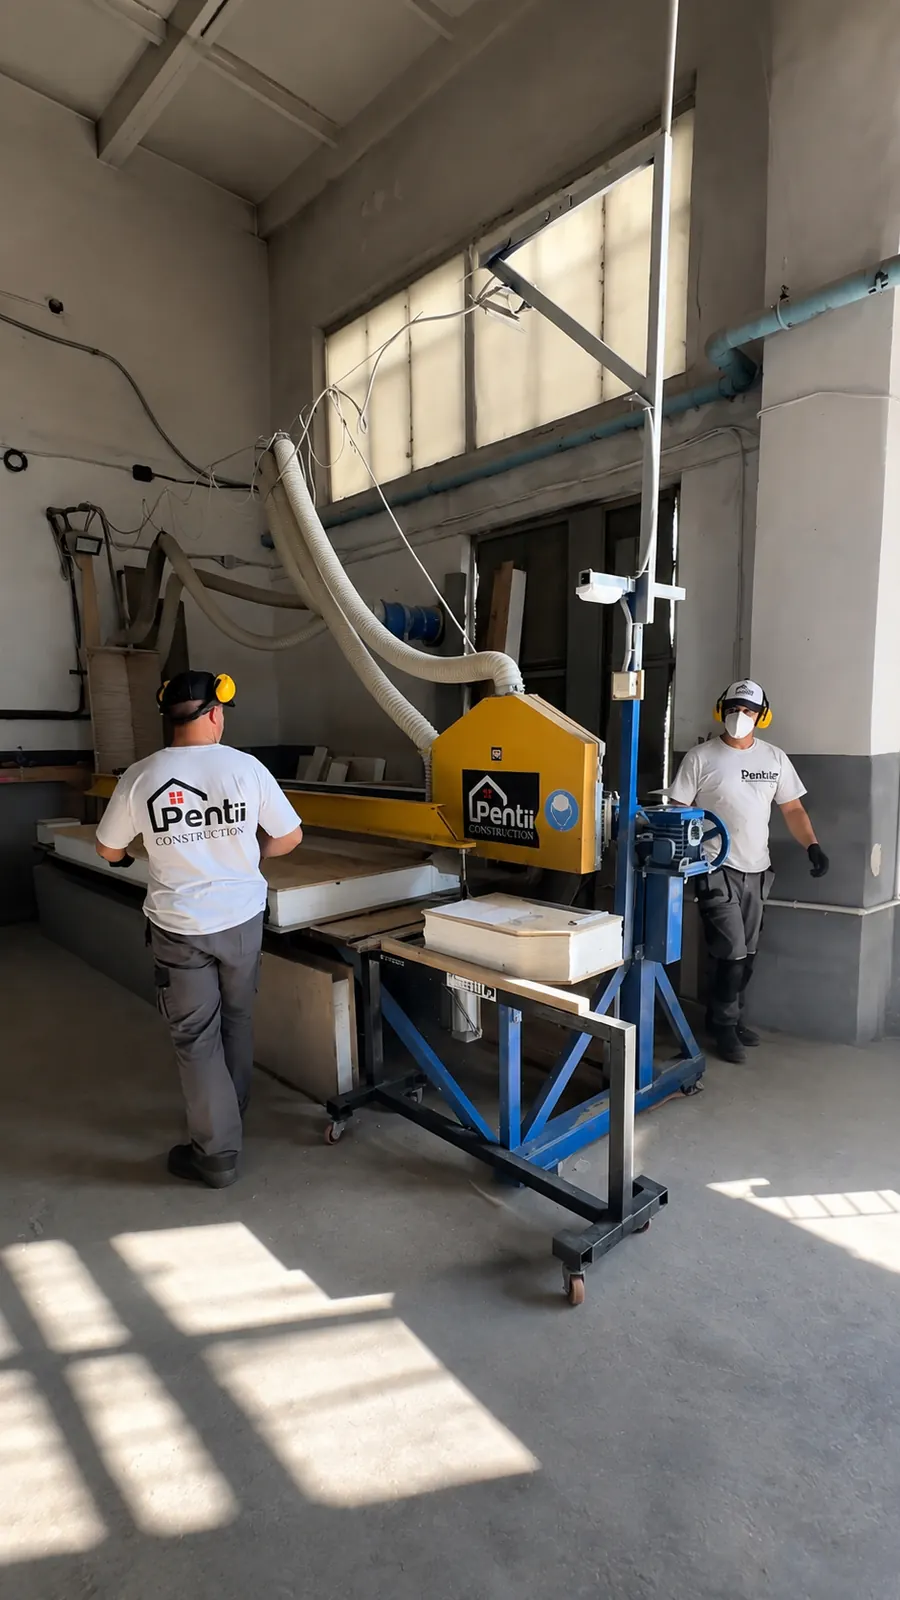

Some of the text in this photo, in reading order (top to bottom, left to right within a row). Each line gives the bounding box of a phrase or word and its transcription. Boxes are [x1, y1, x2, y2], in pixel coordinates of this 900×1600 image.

[160, 799, 246, 832] Pentii
[475, 800, 534, 829] Pentii
[155, 826, 245, 846] CONSTRUCTION
[468, 824, 535, 840] CONSTRUCTION
